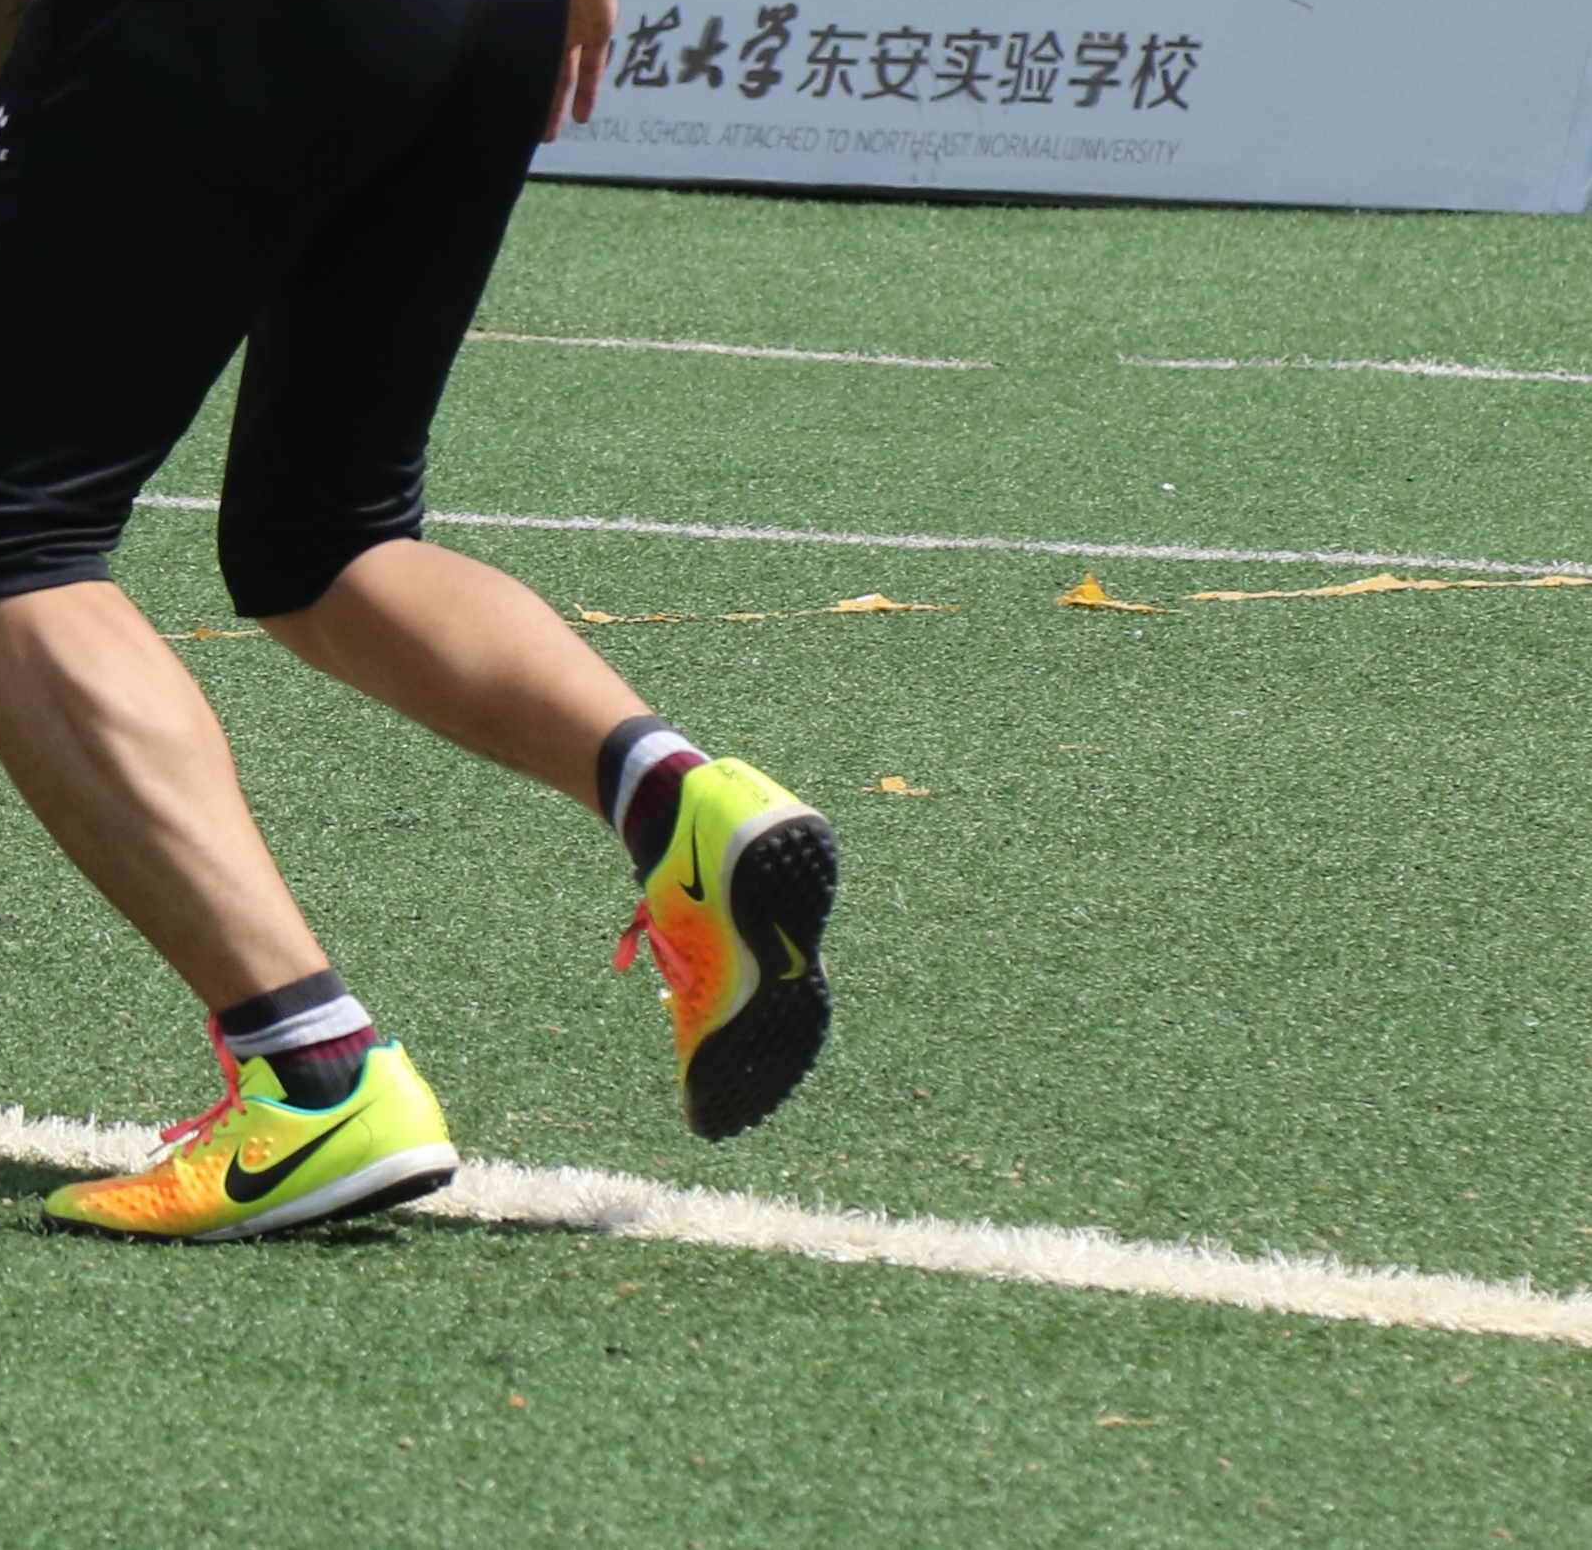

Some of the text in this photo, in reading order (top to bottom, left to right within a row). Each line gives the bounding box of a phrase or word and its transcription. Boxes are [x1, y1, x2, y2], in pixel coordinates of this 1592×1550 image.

[608, 2, 1203, 111] 范大学东安实验学校
[718, 122, 818, 152] ATTACHED
[826, 127, 850, 154] TO
[855, 128, 972, 160] NORTHEAST
[978, 133, 1059, 161] NORMAL
[1064, 136, 1181, 164] UNIVERSITY
